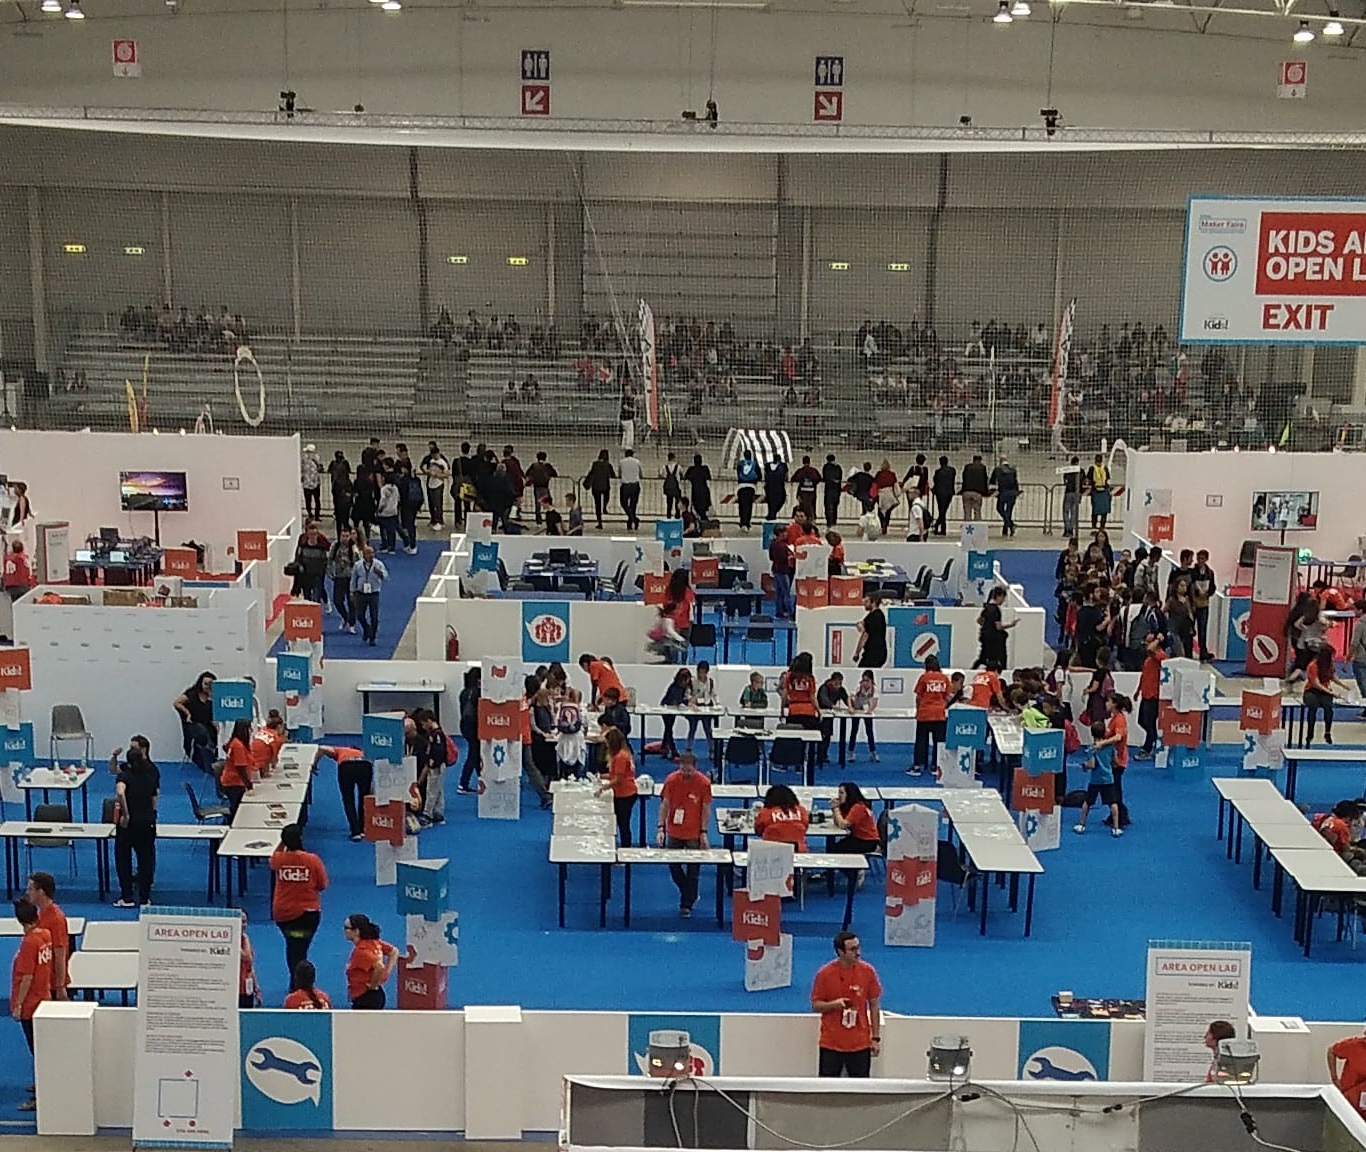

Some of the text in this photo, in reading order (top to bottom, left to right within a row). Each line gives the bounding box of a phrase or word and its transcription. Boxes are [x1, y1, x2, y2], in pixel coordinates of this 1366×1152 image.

[1267, 230, 1334, 254] KIDS
[1266, 257, 1344, 281] OPEN
[1262, 304, 1334, 330] EXIT
[278, 866, 311, 882] Kids!
[155, 928, 229, 939] AREA OPEN LAB
[1162, 963, 1237, 973] AREA OPEN LAB
